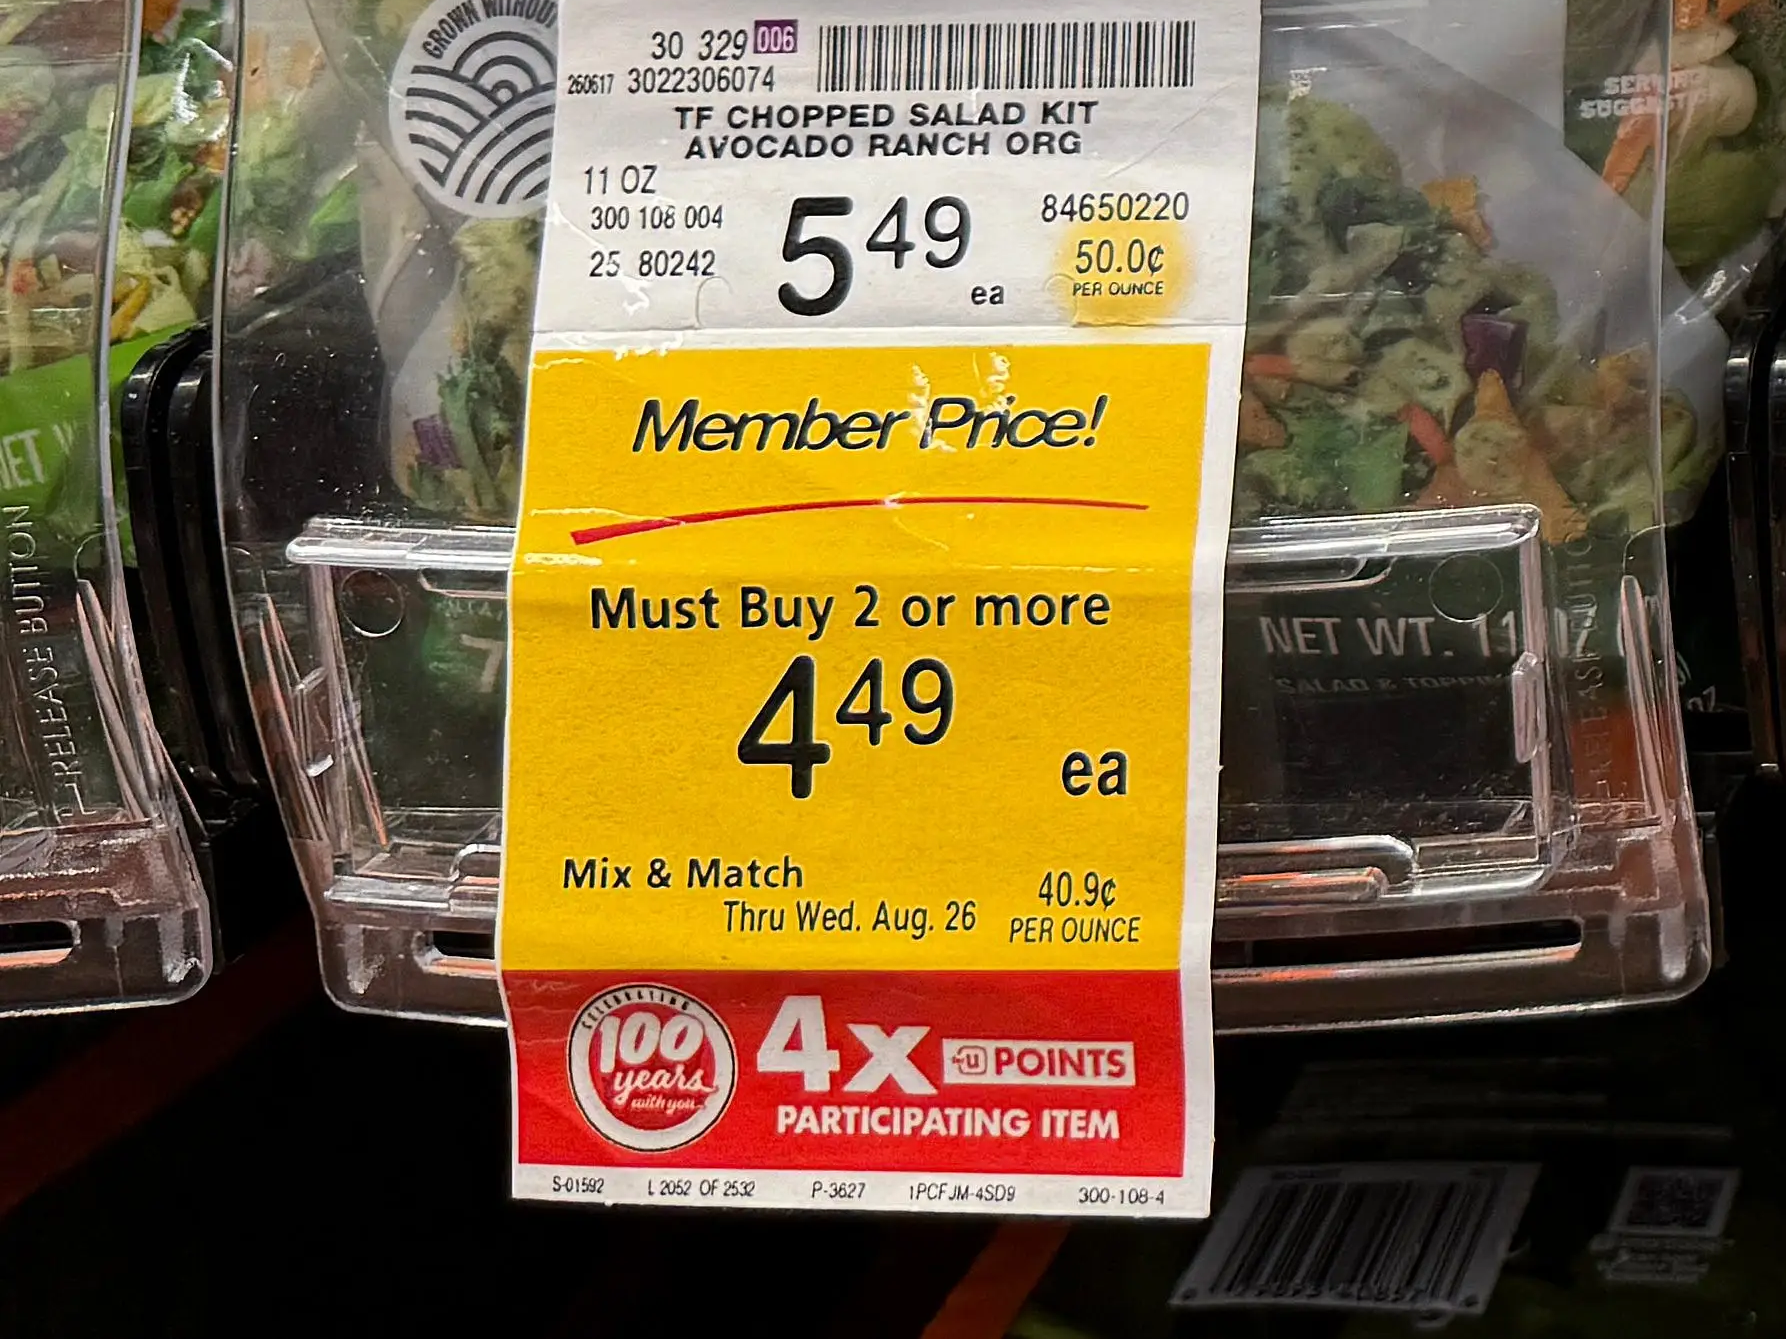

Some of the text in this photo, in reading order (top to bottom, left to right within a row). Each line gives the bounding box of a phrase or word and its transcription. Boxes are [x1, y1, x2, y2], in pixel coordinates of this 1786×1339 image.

[628, 66, 775, 94] 3022306074
[675, 101, 1098, 130] TF CHOPPED SALAD KIT
[685, 132, 1081, 158] AVOCADO RANCH ORG
[1041, 194, 1189, 221] 84650220
[1074, 240, 1164, 275] 50.0¢
[2, 504, 49, 637] BUTTON
[1038, 870, 1116, 909] 40.9¢
